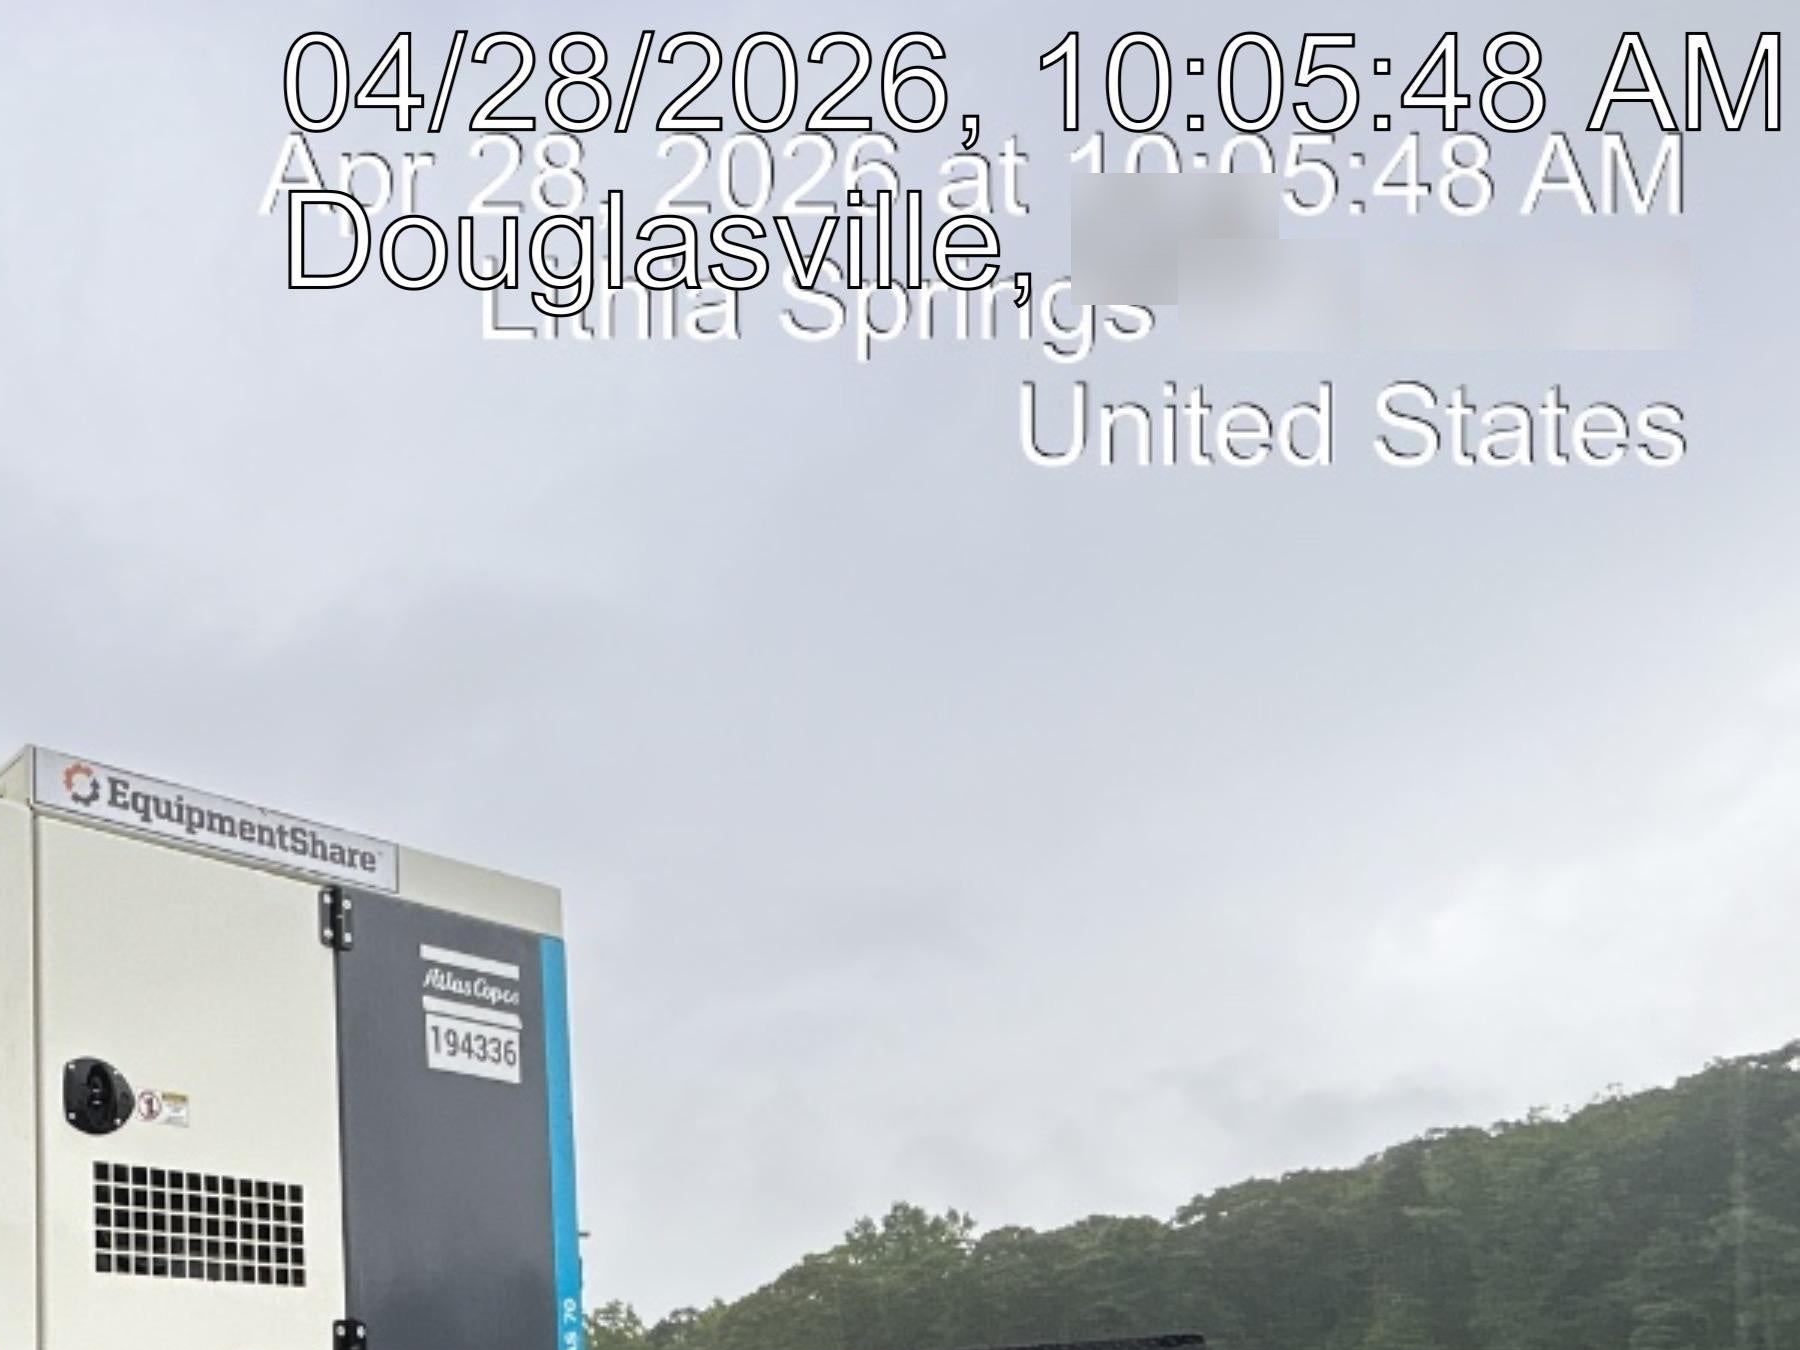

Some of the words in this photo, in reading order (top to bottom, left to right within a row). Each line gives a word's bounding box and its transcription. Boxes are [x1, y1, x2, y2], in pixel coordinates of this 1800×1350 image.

[107, 777, 377, 872] EquipmentShare
[423, 967, 472, 997] Atlas
[430, 1024, 517, 1067] 194336
[563, 1297, 577, 1325] 70
